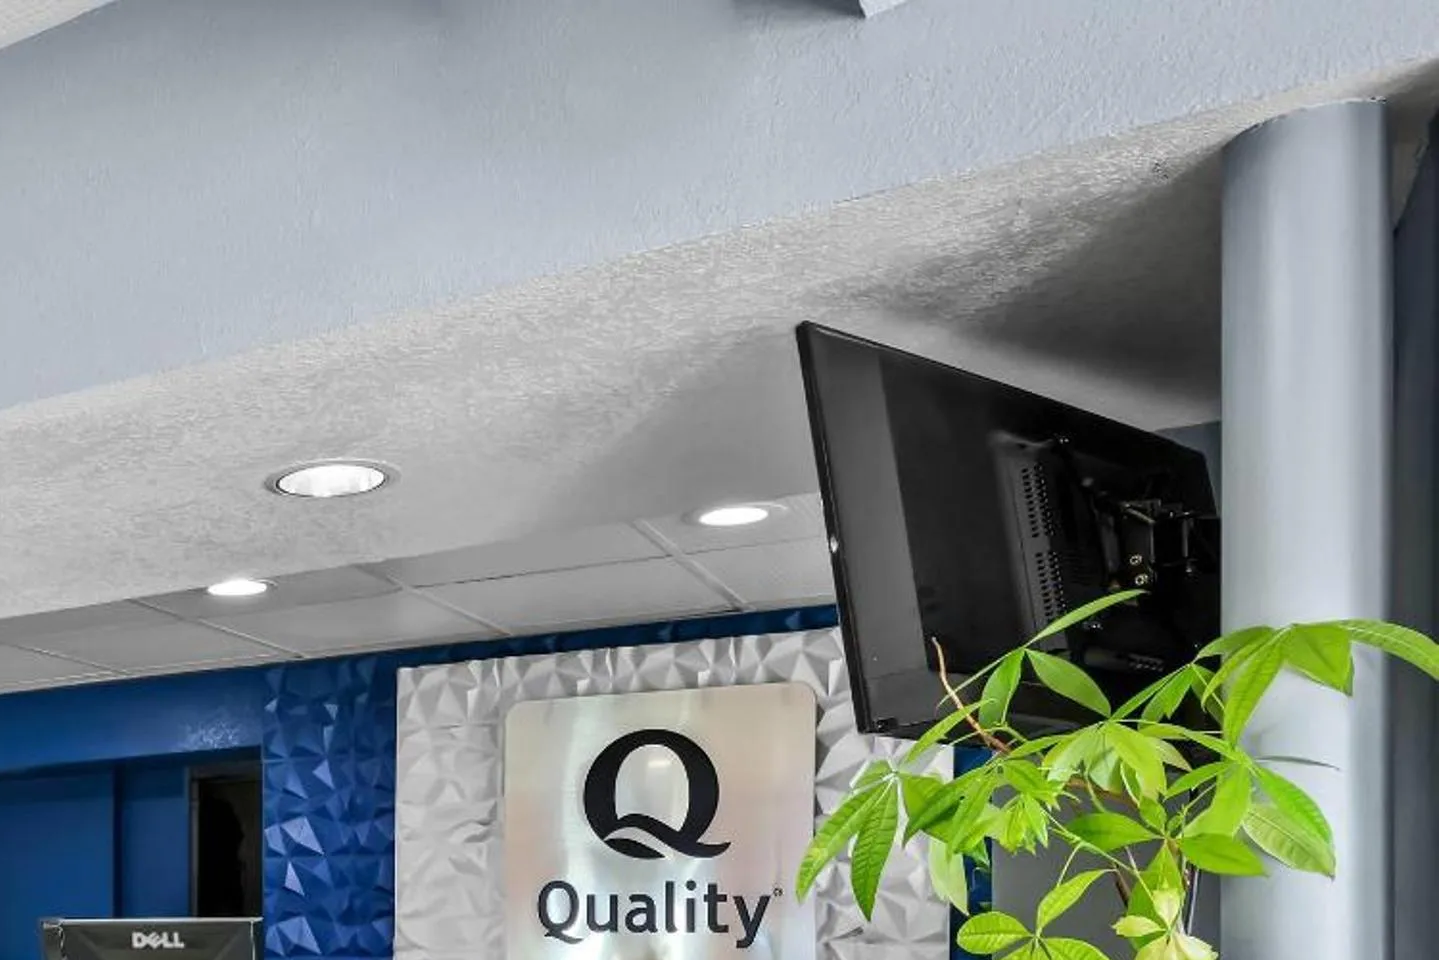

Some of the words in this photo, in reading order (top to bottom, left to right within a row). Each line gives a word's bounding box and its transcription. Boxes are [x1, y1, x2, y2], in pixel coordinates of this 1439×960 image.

[583, 728, 732, 860] Q
[131, 931, 185, 949] DELL
[537, 880, 772, 949] Quality
